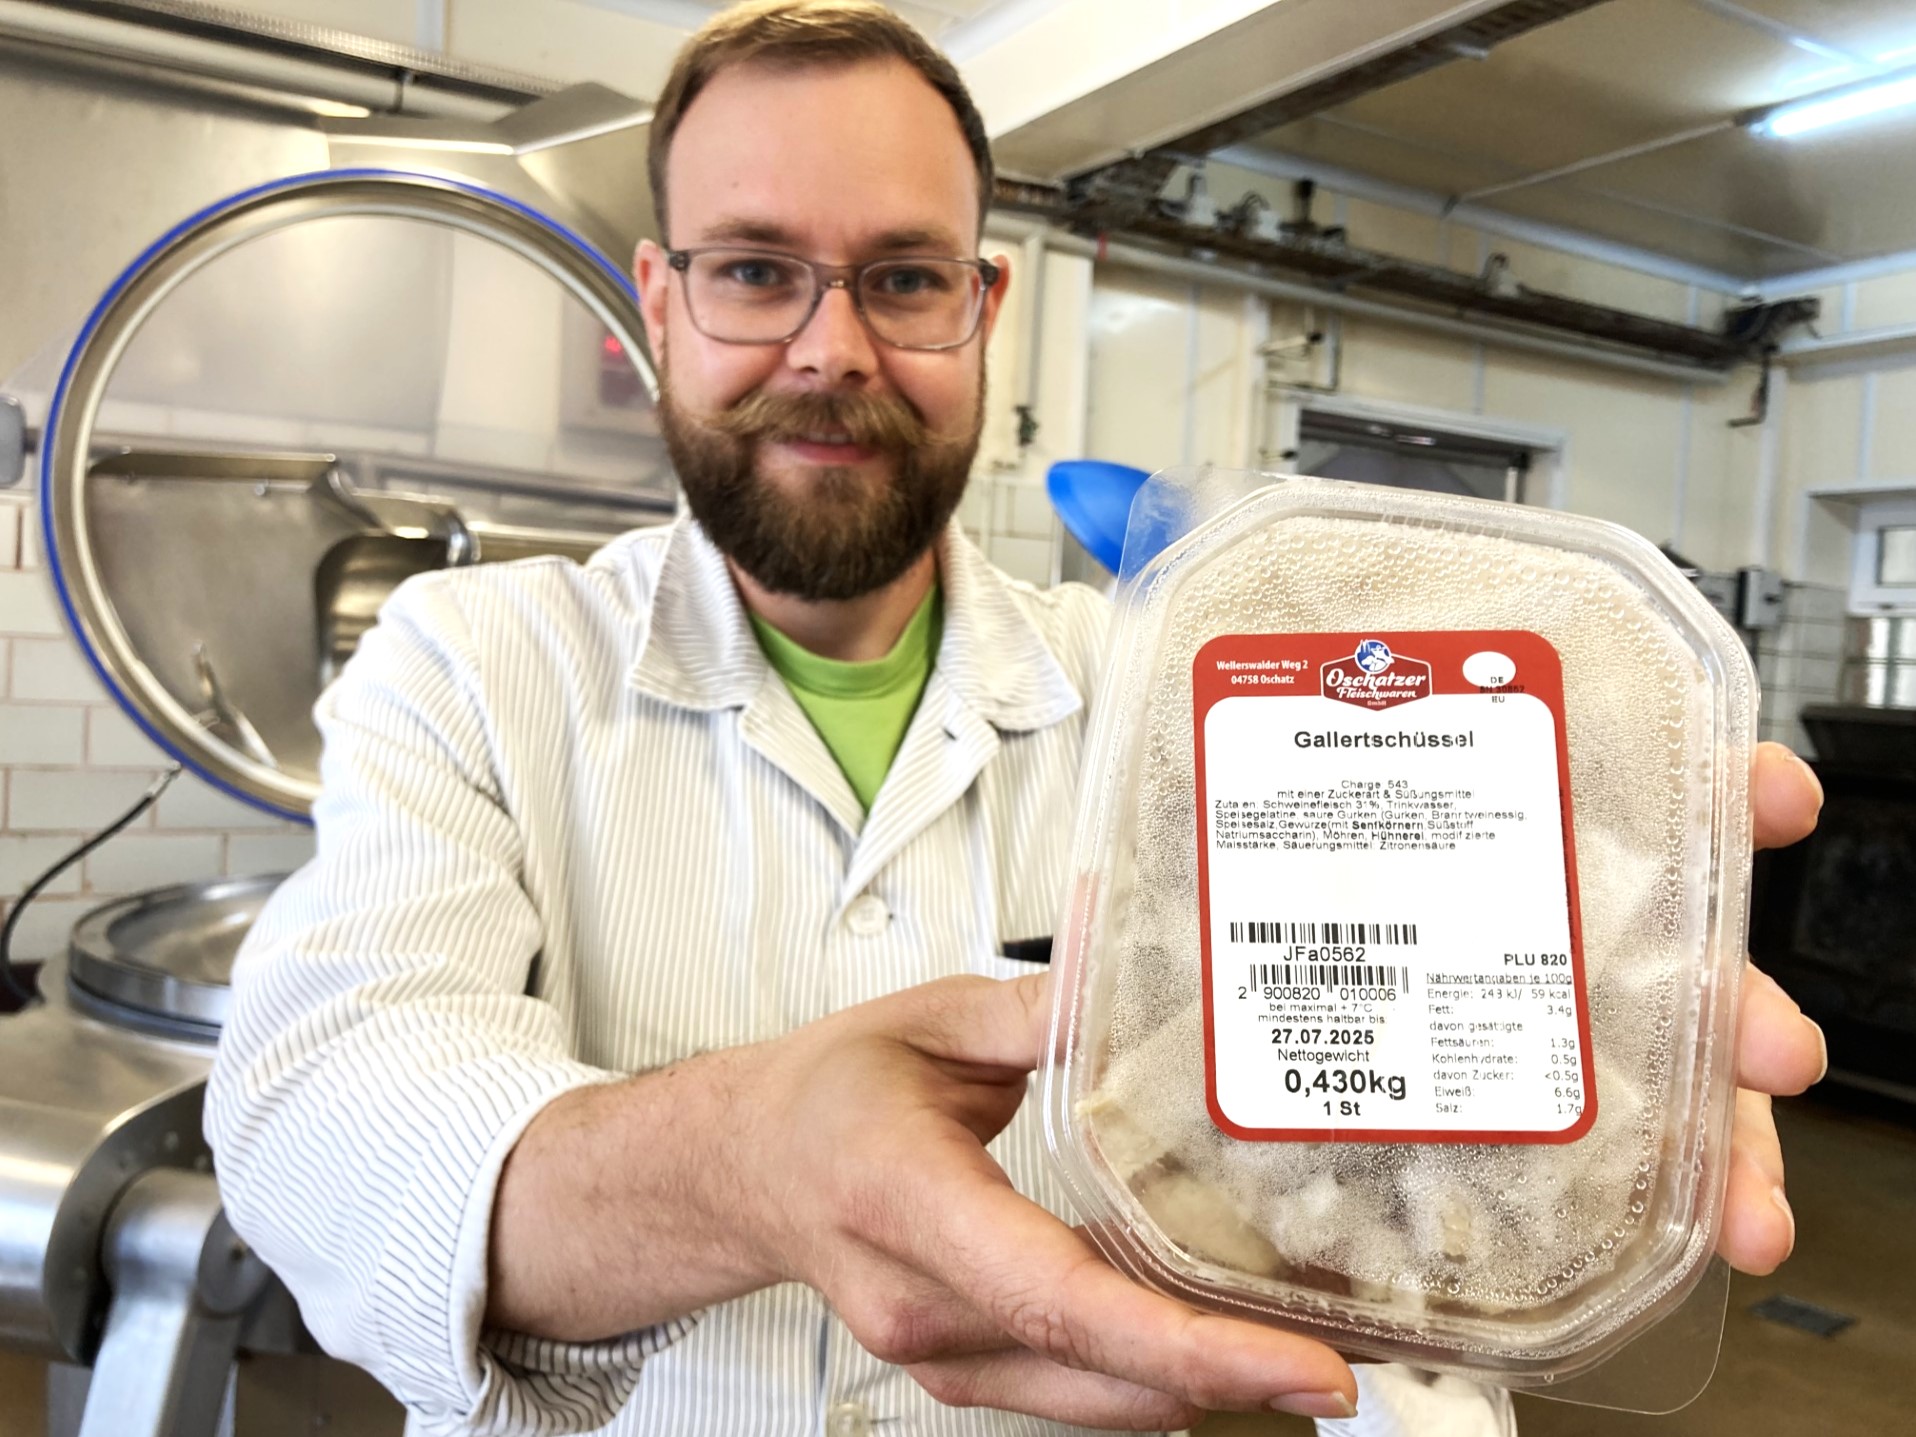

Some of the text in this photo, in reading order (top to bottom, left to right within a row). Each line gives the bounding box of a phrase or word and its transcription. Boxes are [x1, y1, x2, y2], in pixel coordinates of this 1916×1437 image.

[1216, 660, 1308, 671] Wellerswalder Weg 2
[1231, 674, 1295, 684] 04758 Oschatz
[1325, 668, 1427, 689] Oschatzer
[1336, 687, 1417, 700] Fleischwaren
[1294, 730, 1474, 748] Gallertschüssel
[1388, 780, 1408, 789] 543
[1277, 789, 1475, 801] mit einer Zuckerart & Süßungsmittel
[1263, 800, 1351, 809] Schweinefleisch
[1303, 811, 1333, 819] saure
[1337, 810, 1377, 819] Gurken
[1431, 831, 1496, 840] modifzierte
[1380, 841, 1456, 850] Zitronensäure
[1283, 945, 1366, 962] JFa0562
[1504, 953, 1568, 966] PLU 820
[1426, 972, 1572, 985] Nährwertangaben je 100g
[1238, 986, 1396, 1001] 2 900820 010006
[1427, 988, 1474, 1001] Energie:
[1531, 988, 1545, 999] 59
[1549, 988, 1571, 999] kcal
[1269, 1002, 1286, 1012] bei
[1290, 1002, 1337, 1012] maximal
[1428, 1004, 1572, 1018] Fett: 3.4g
[1258, 1013, 1323, 1023] mindestens
[1326, 1014, 1364, 1024] haltbar
[1429, 1020, 1464, 1031] davon
[1271, 1028, 1375, 1045] 27.07.2025
[1551, 1038, 1575, 1050] 1.3g
[1278, 1048, 1370, 1064] Nettogewicht
[1432, 1053, 1577, 1067] Kohlenhydrate: 0.5g
[1433, 1069, 1579, 1083] davon Zucker: <0.5g
[1284, 1068, 1407, 1101] 0,430kg
[1554, 1087, 1580, 1100] 6.6g
[1323, 1101, 1361, 1116] 1 St
[1436, 1102, 1583, 1117] Salz: 1.7g
